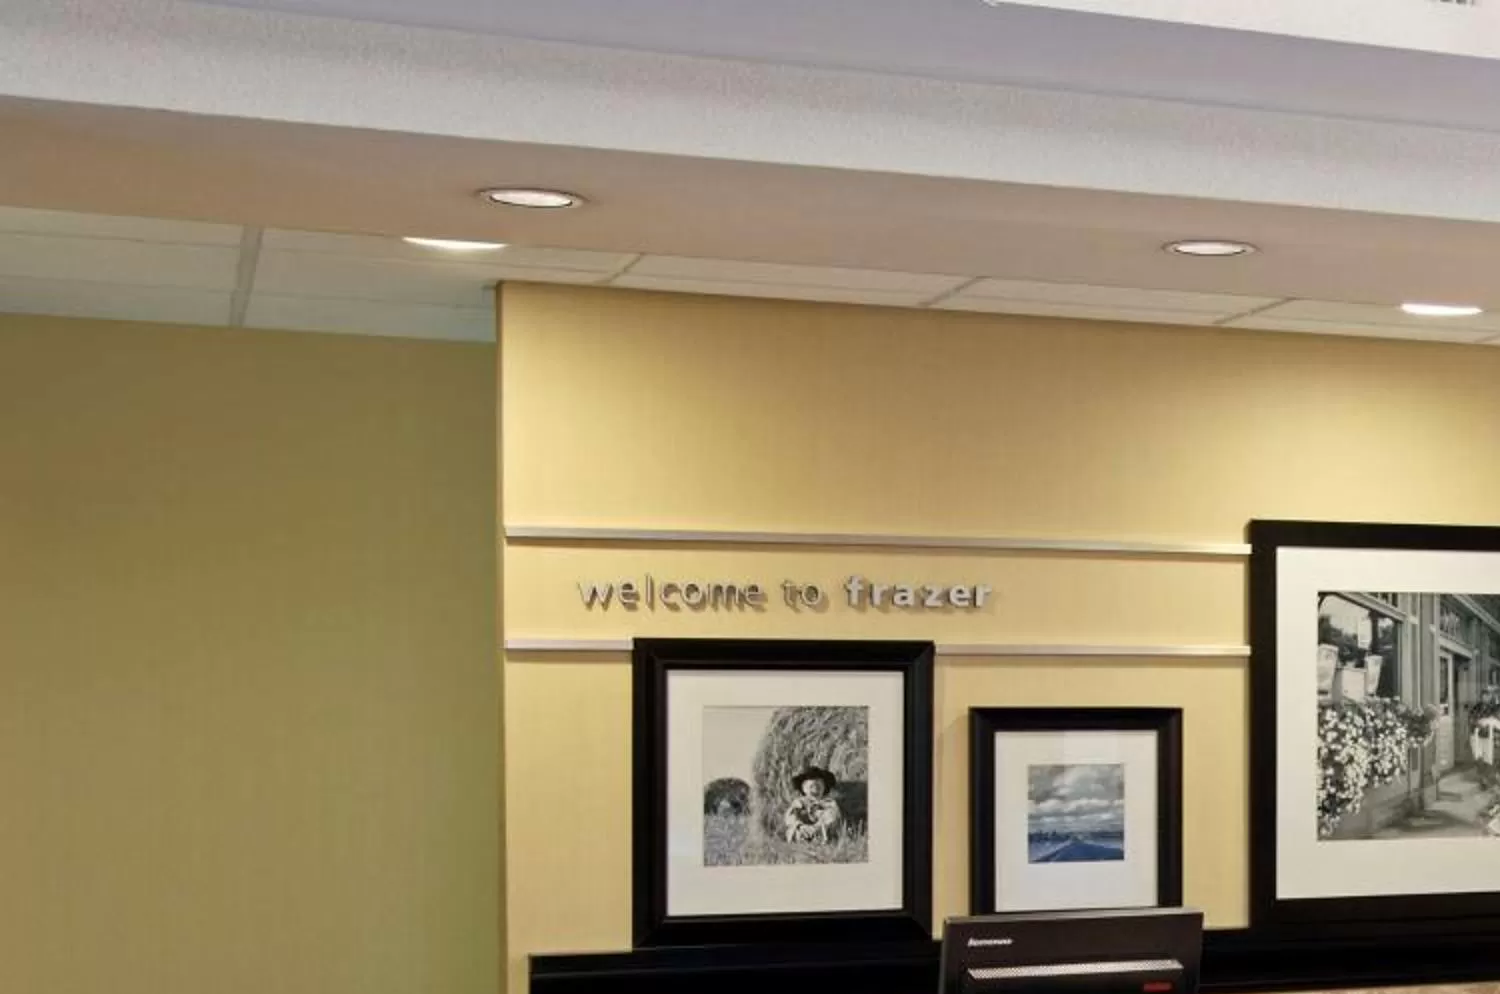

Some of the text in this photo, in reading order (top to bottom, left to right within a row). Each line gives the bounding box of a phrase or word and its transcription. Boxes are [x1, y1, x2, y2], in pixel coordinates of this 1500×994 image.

[577, 573, 993, 611] welcome to frazer
